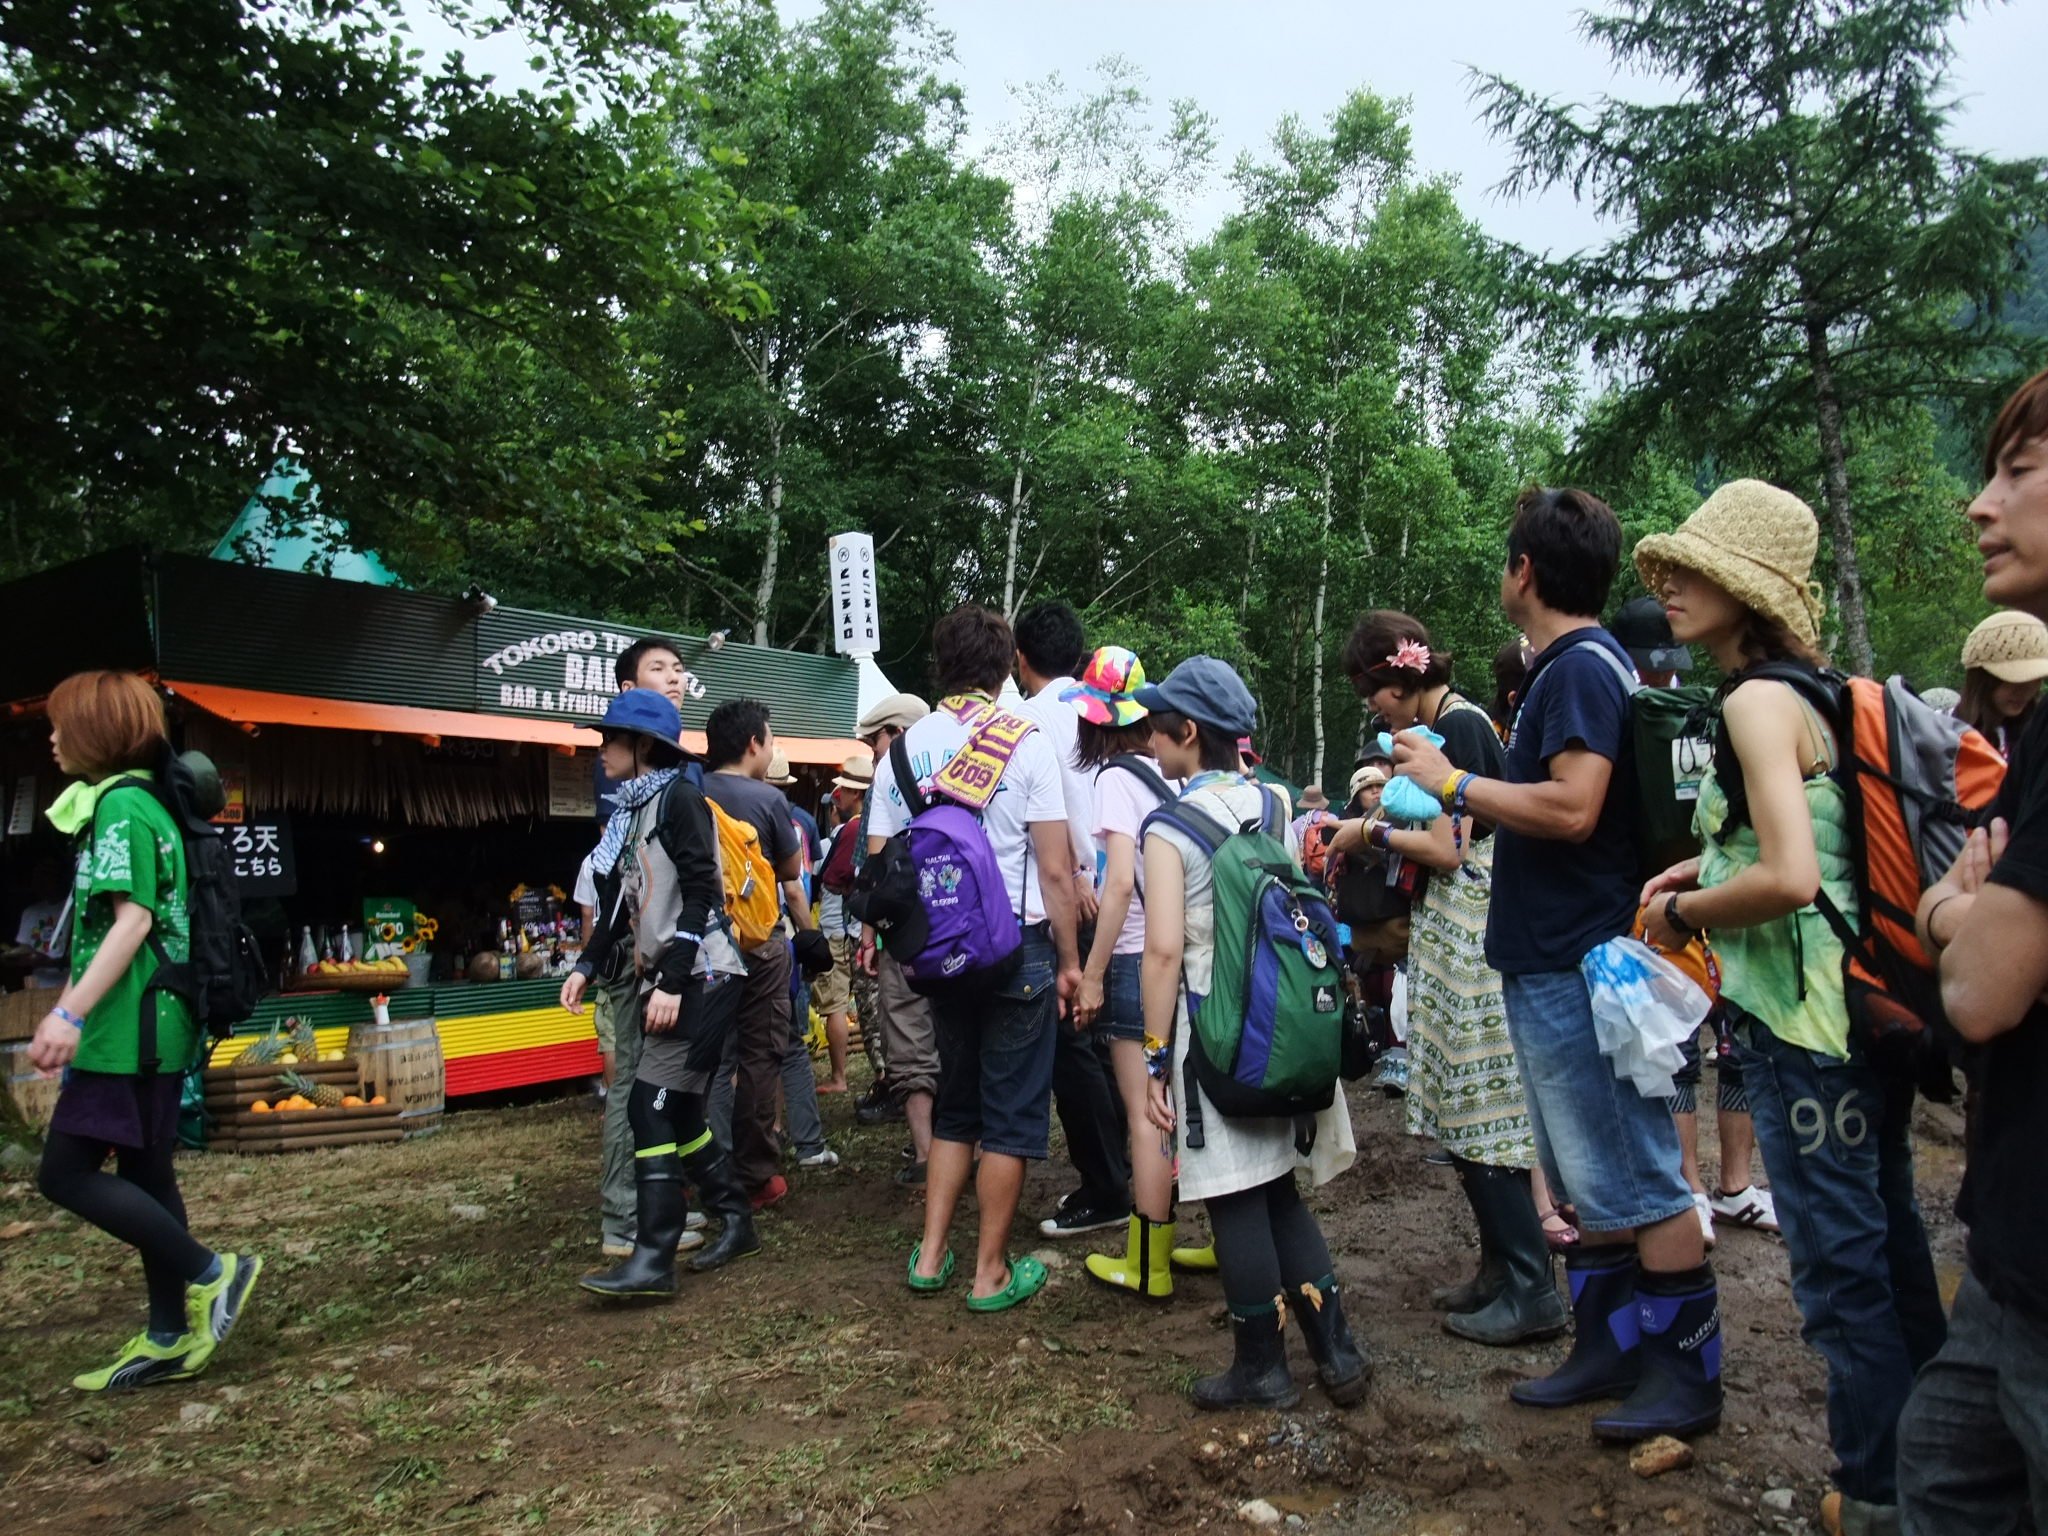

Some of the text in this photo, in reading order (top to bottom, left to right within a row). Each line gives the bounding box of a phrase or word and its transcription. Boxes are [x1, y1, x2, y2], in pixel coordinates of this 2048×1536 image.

[482, 630, 597, 675] TOKORO
[500, 683, 609, 716] BAR & Fruits
[233, 856, 282, 876] こちら
[1790, 1088, 1868, 1155] 96
